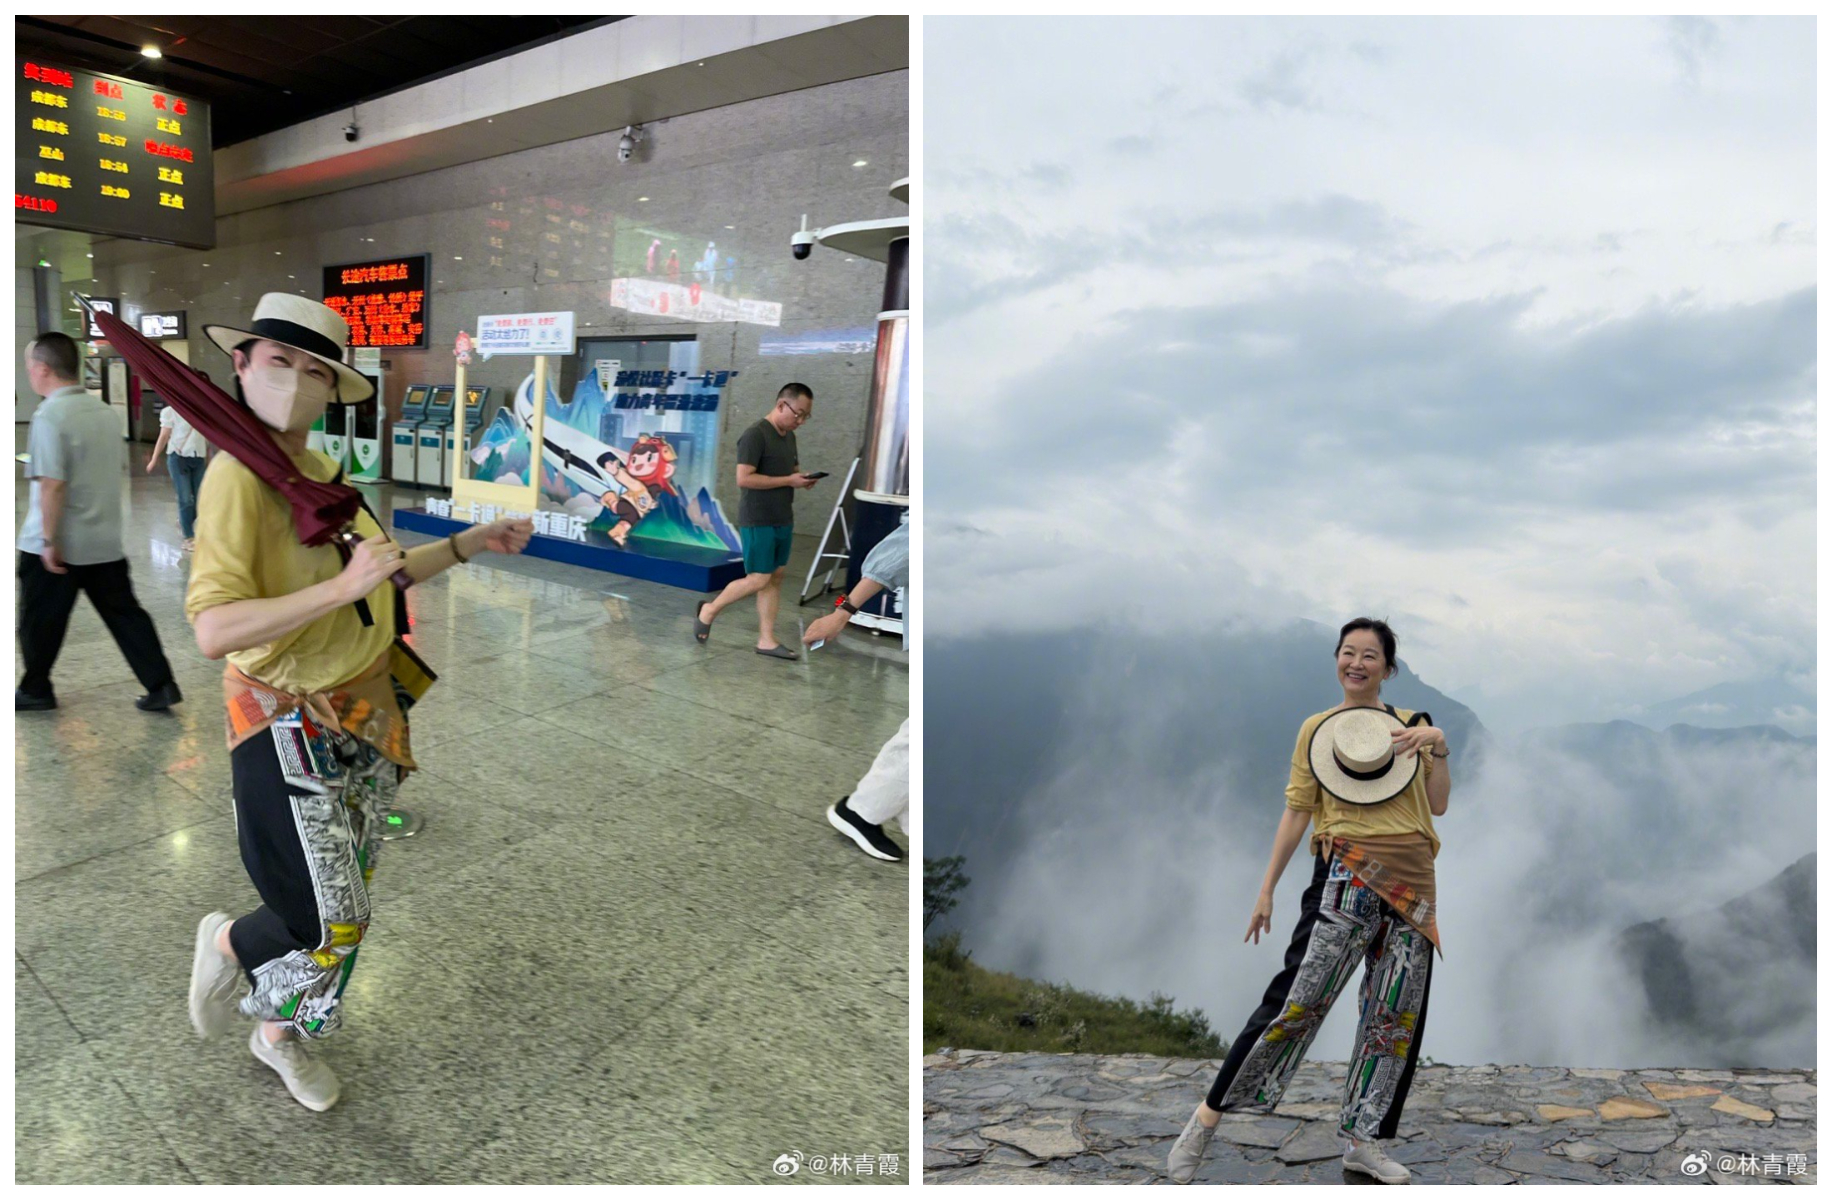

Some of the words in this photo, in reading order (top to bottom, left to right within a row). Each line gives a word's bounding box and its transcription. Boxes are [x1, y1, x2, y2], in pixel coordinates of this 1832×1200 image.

[31, 90, 68, 108] 成都东
[156, 117, 182, 135] 正点
[32, 117, 69, 135] 成都东
[158, 167, 184, 185] 正点
[35, 171, 72, 189] 成都东
[159, 192, 185, 210] 正点
